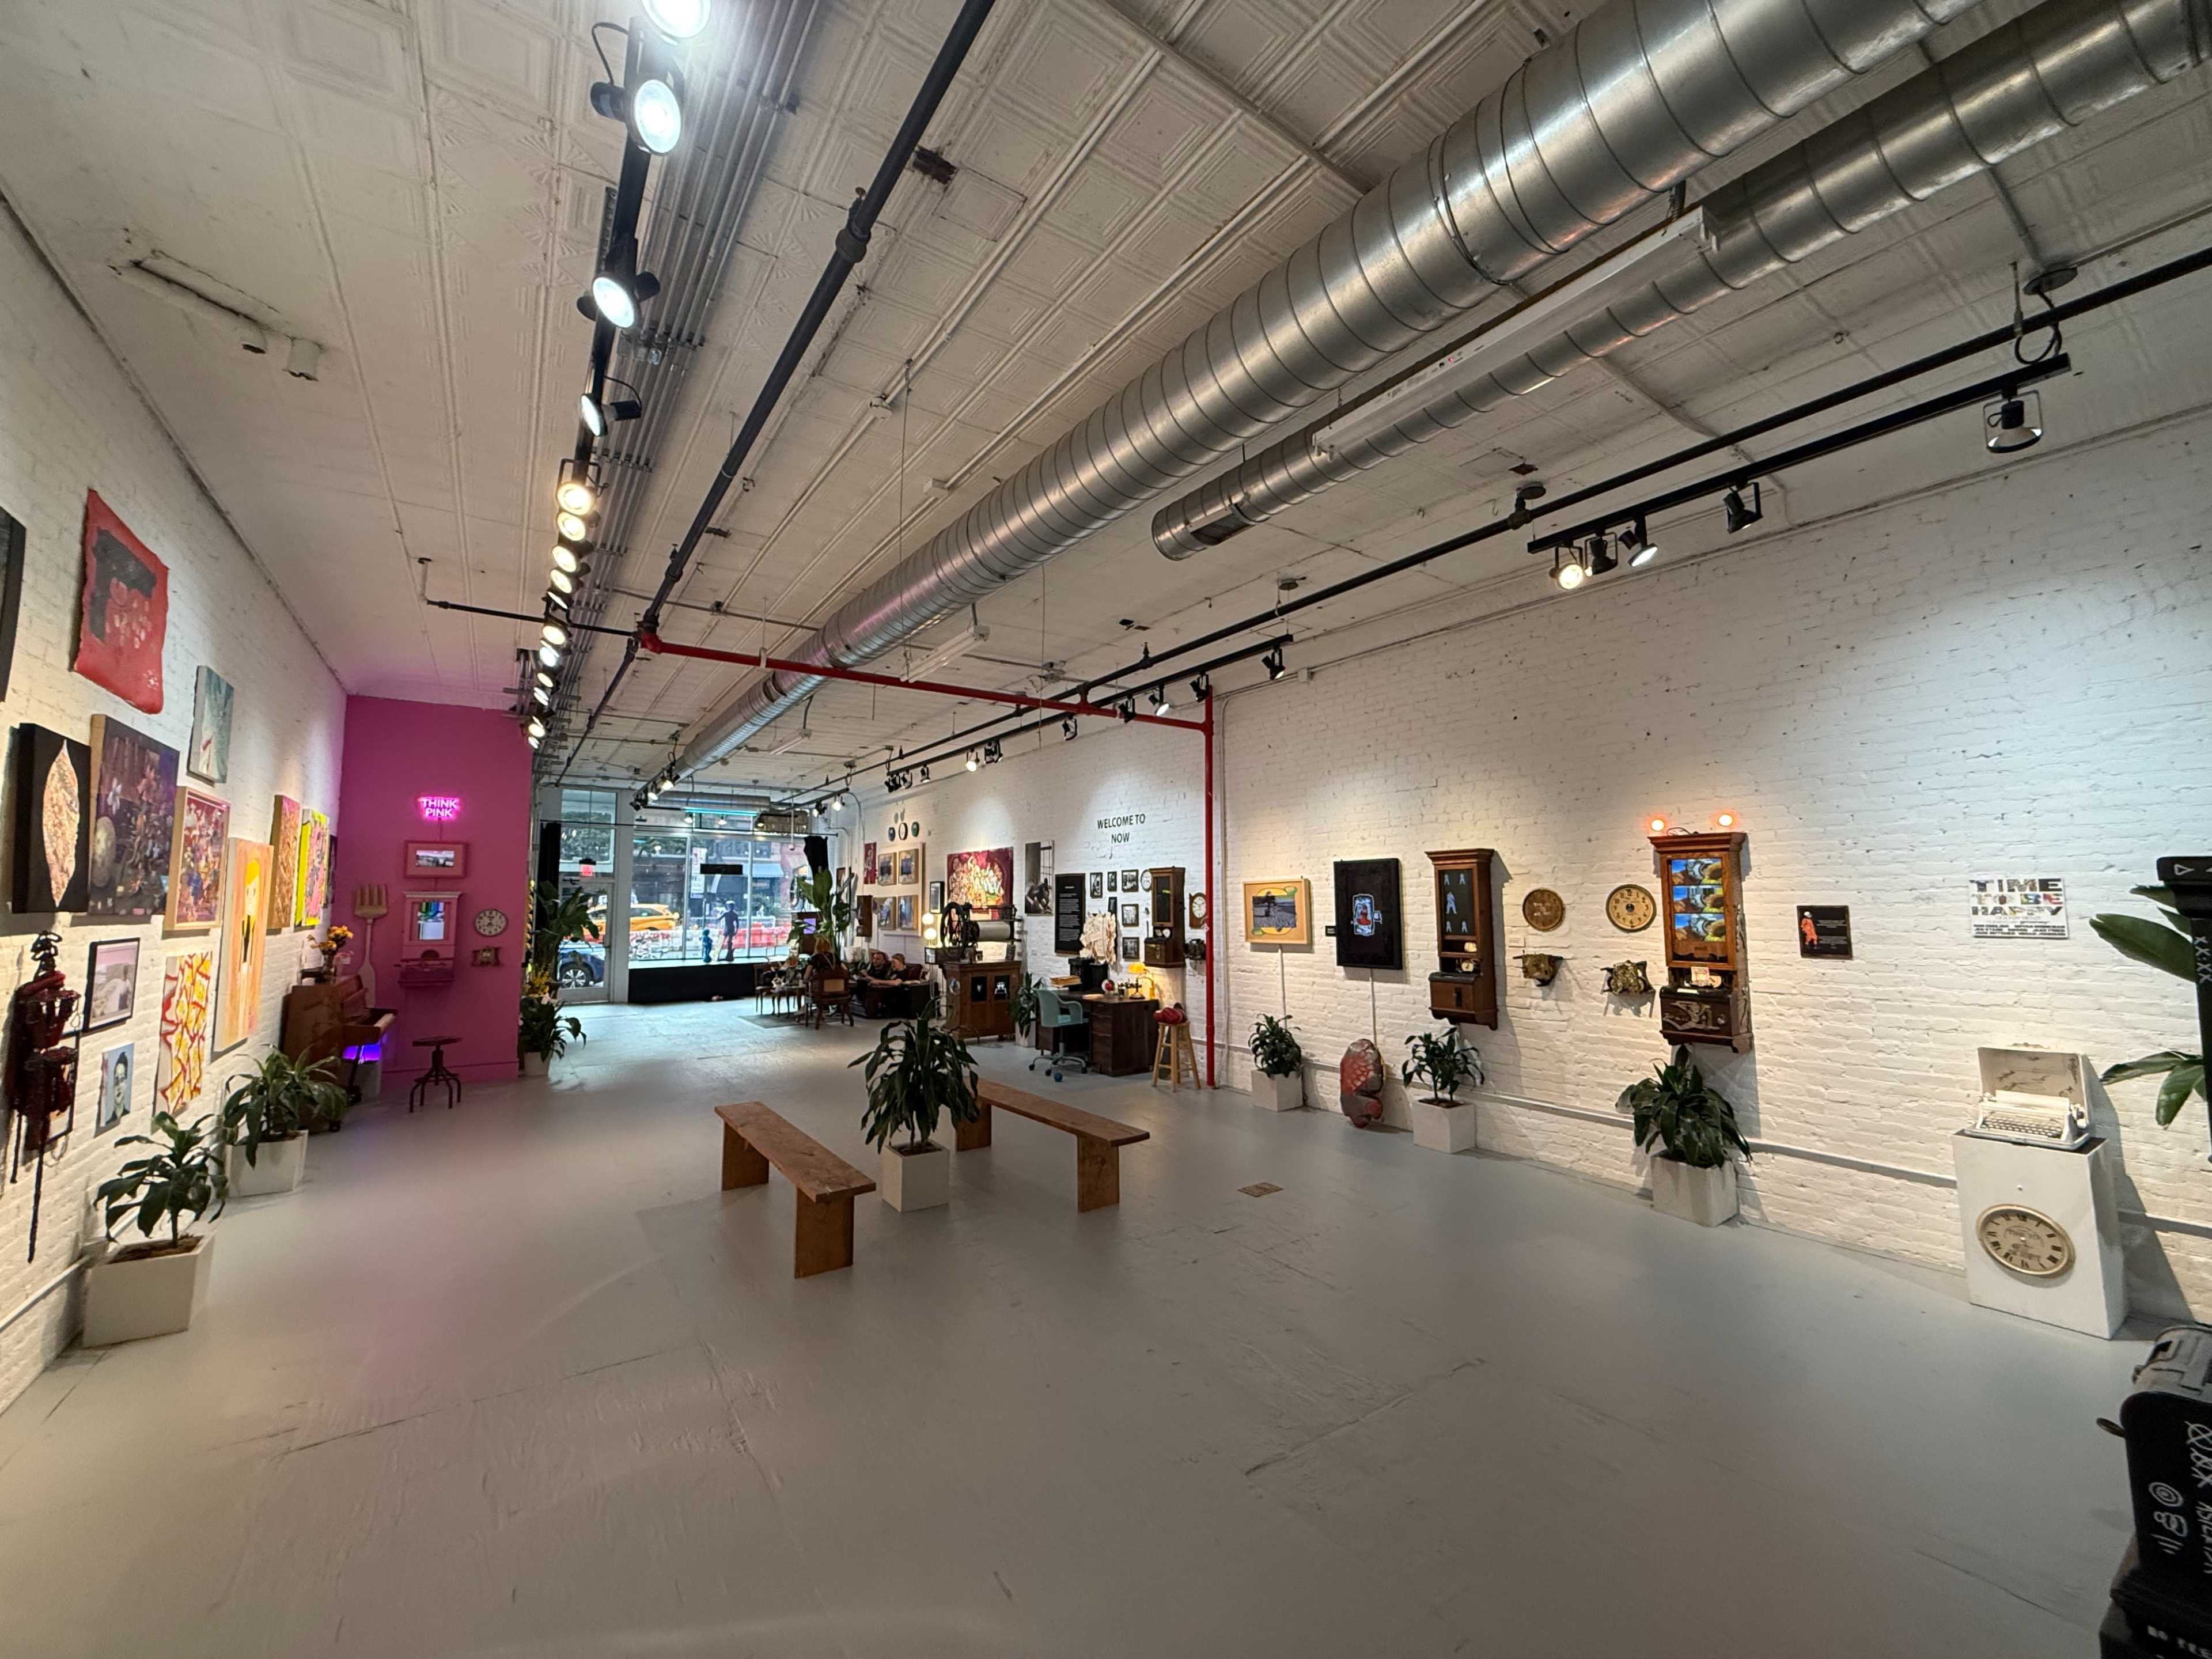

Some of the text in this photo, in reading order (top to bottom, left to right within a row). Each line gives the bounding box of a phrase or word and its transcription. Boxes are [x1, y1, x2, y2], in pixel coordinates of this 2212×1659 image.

[421, 798, 457, 809] THINK
[425, 808, 453, 817] PINK
[1097, 813, 1146, 830] WELCOME TO
[1111, 832, 1130, 844] NOW
[1969, 878, 2062, 892] TIME
[1971, 893, 2063, 905] TO BE
[1971, 906, 2063, 915] HAPPY
